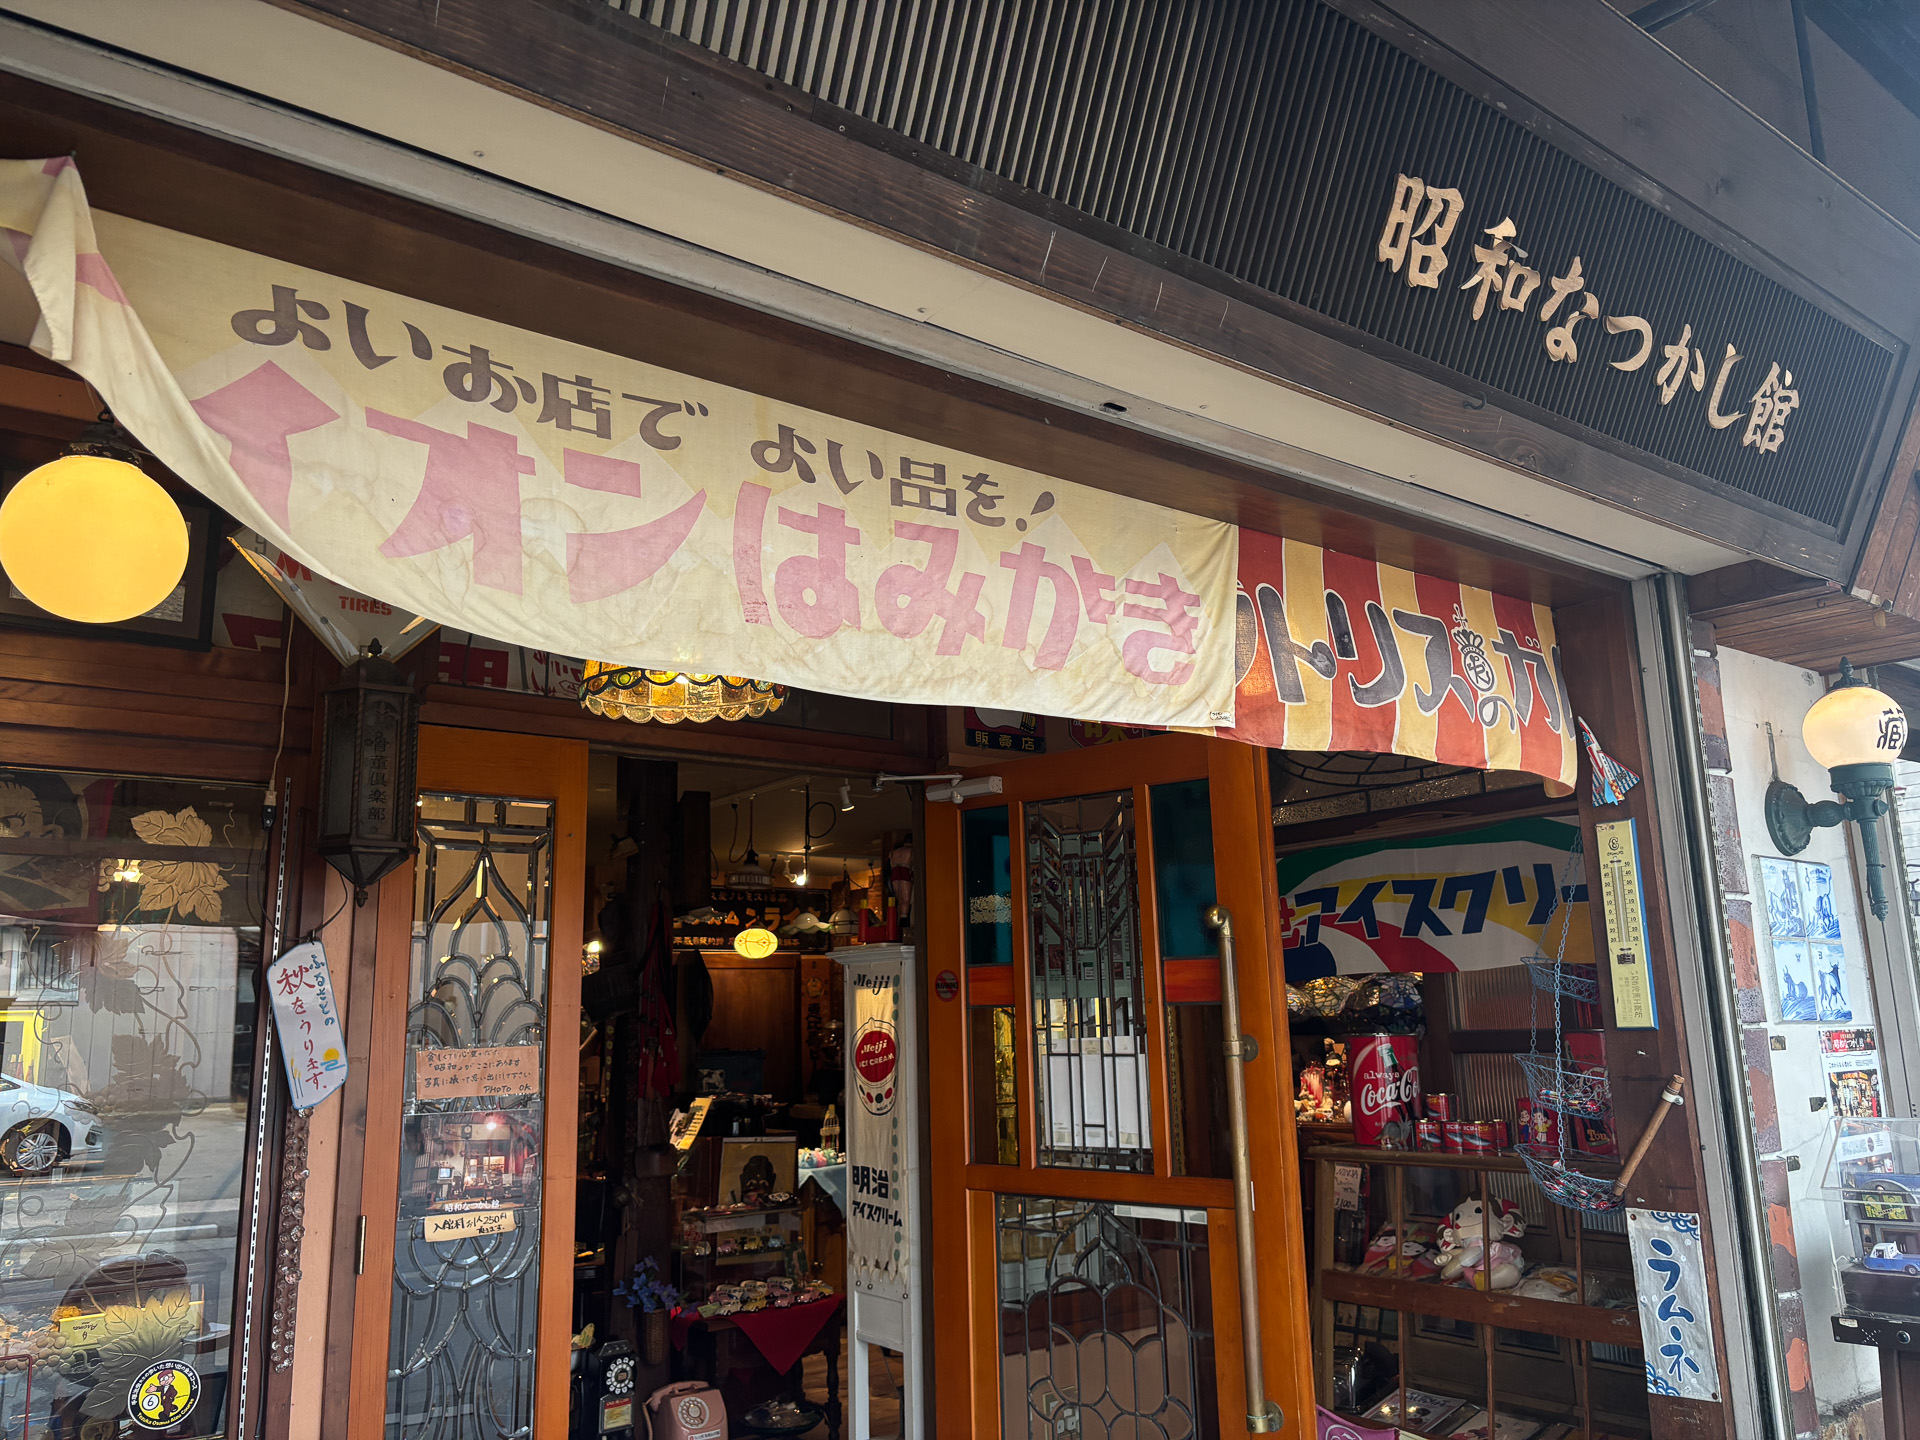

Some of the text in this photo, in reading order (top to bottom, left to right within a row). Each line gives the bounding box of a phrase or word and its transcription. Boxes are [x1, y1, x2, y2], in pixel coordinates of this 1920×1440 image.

[1377, 172, 1801, 455] 昭和なつかし館
[230, 284, 709, 450] よいお店で
[338, 595, 393, 616] TIRES
[309, 954, 336, 1026] ふるさとの
[853, 973, 890, 995] Meiji
[861, 1039, 888, 1055] Meiji
[869, 1052, 895, 1066] CREAM
[1363, 1070, 1400, 1080] always
[483, 1083, 532, 1094] PHOTO OK
[852, 1165, 889, 1199] 明治
[852, 1200, 903, 1227] アイスクリーム
[1648, 1236, 1702, 1383] ラムネ
[147, 1396, 155, 1407] 6
